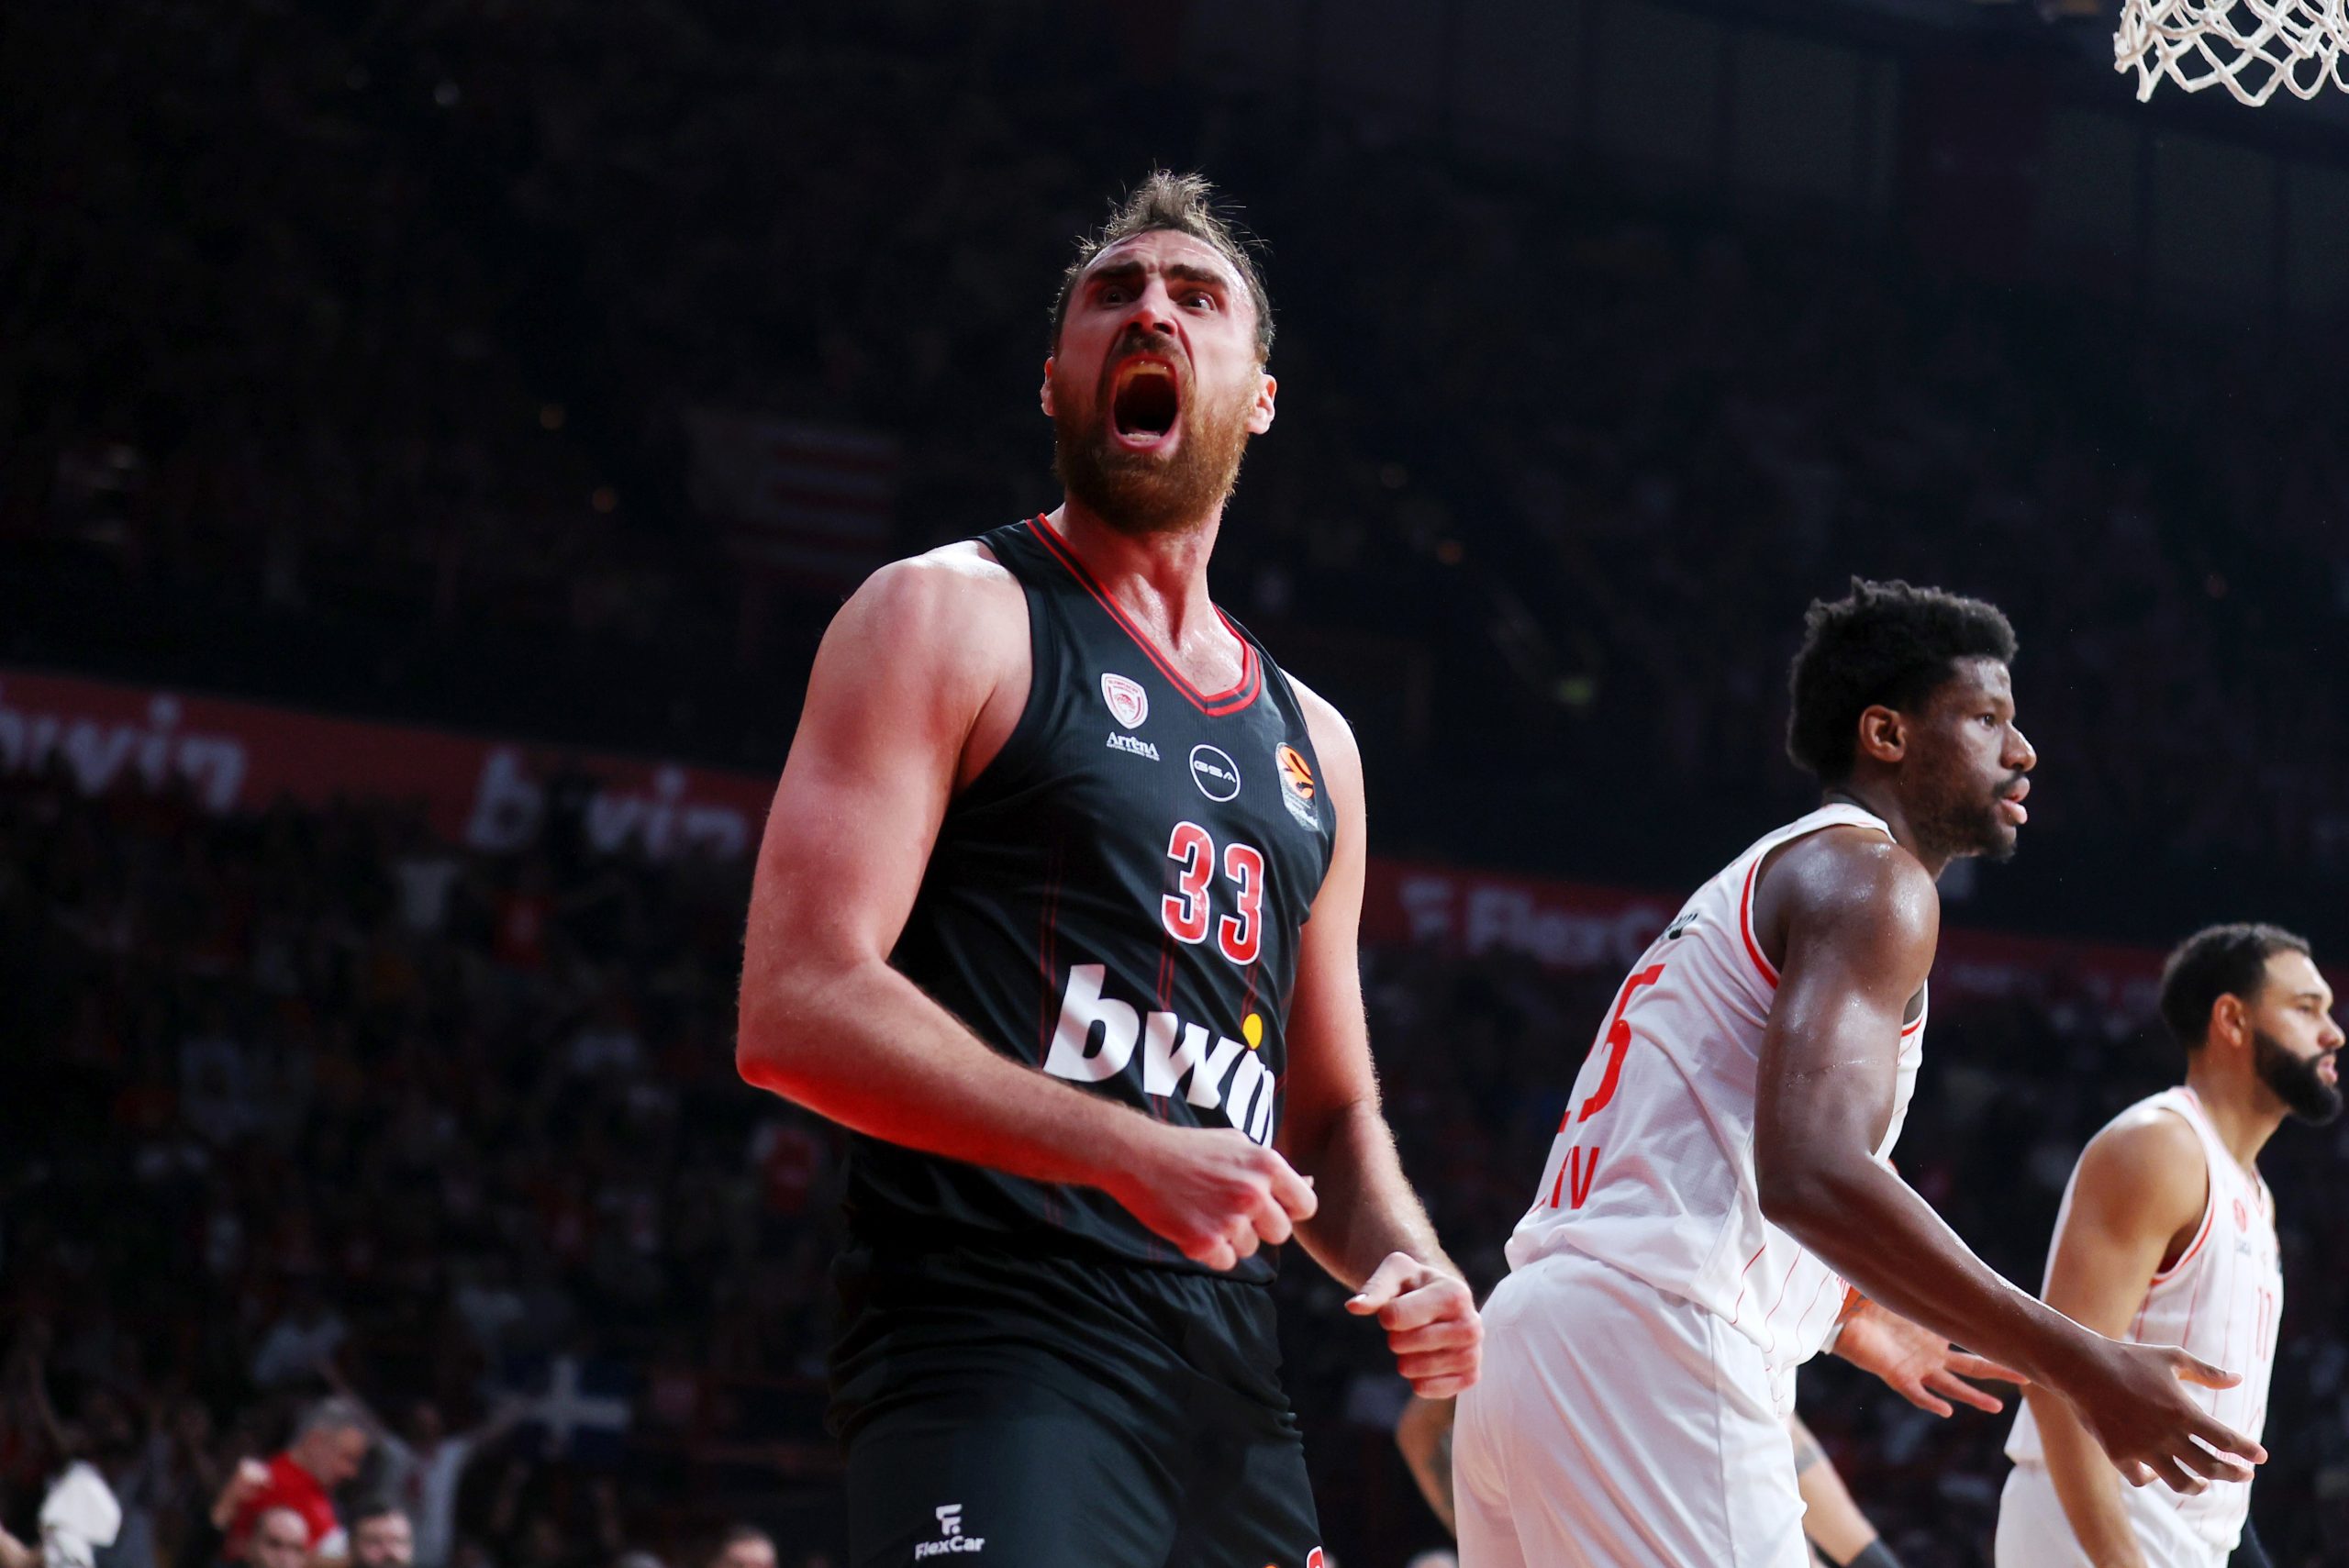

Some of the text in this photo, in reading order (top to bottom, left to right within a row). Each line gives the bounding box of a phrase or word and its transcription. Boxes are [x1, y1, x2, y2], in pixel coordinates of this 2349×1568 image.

[0, 679, 246, 811] win
[1194, 760, 1236, 783] GSA
[1161, 821, 1264, 965] 33
[1042, 963, 1275, 1147] bwin
[1557, 963, 1666, 1134] 5
[915, 1535, 985, 1561] FlexCar
